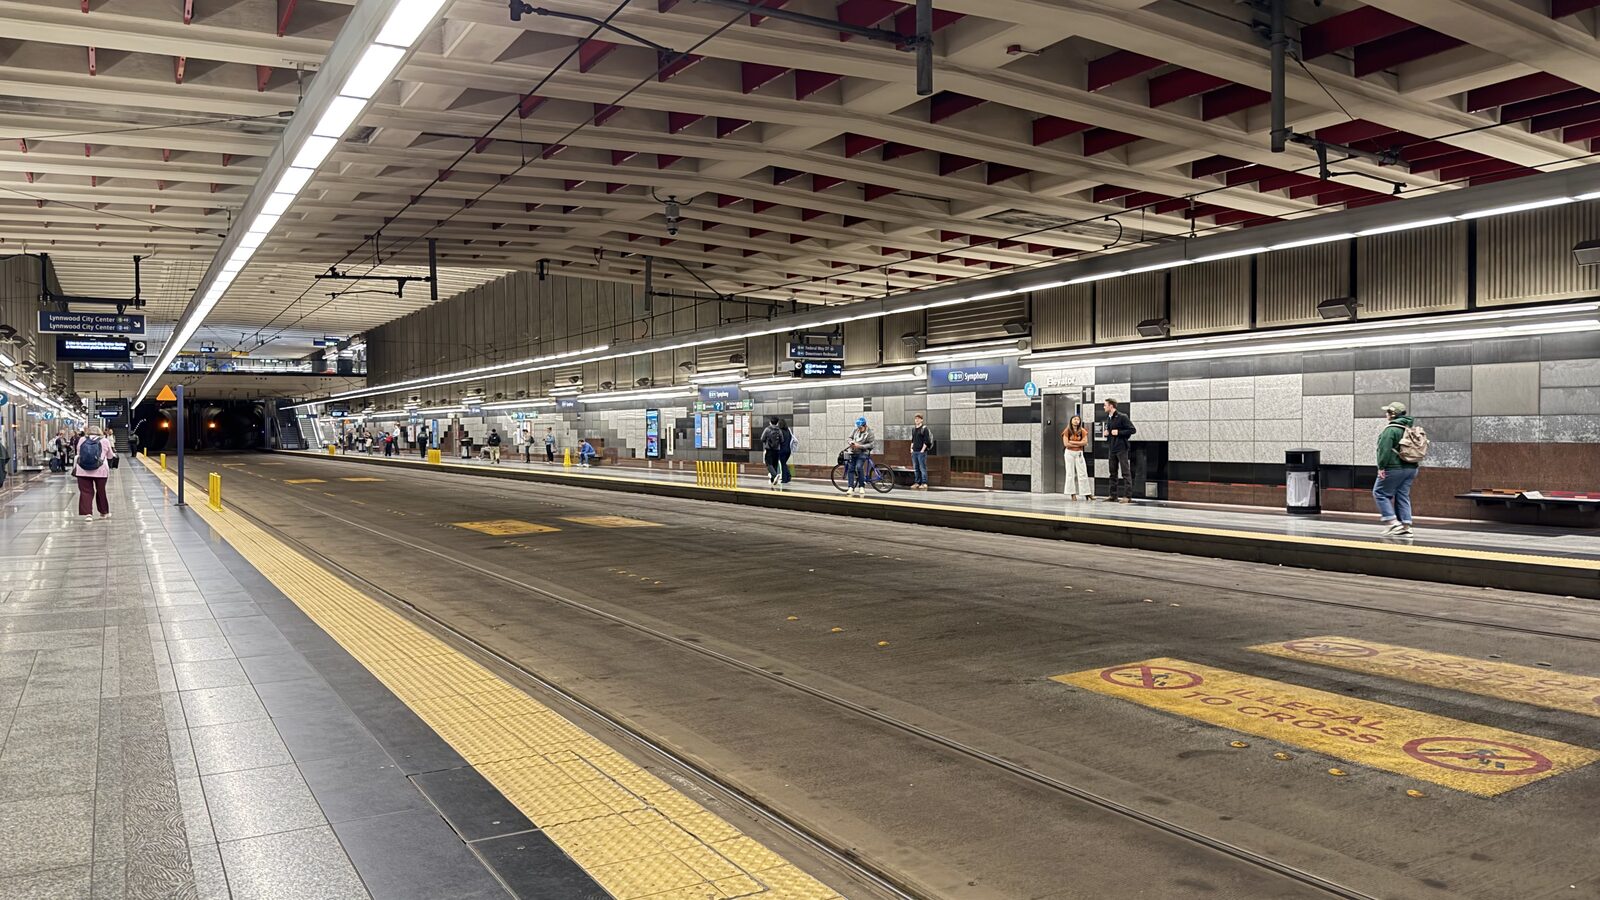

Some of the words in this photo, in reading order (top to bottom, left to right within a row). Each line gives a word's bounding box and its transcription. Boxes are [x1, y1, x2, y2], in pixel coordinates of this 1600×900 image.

[81, 315, 94, 323] City
[81, 323, 94, 331] City
[964, 372, 988, 382] Symphony
[1047, 376, 1077, 387] Elevator
[1225, 688, 1385, 731] ILLEGAL
[1182, 691, 1233, 706] TO
[1237, 706, 1385, 744] CROSS
